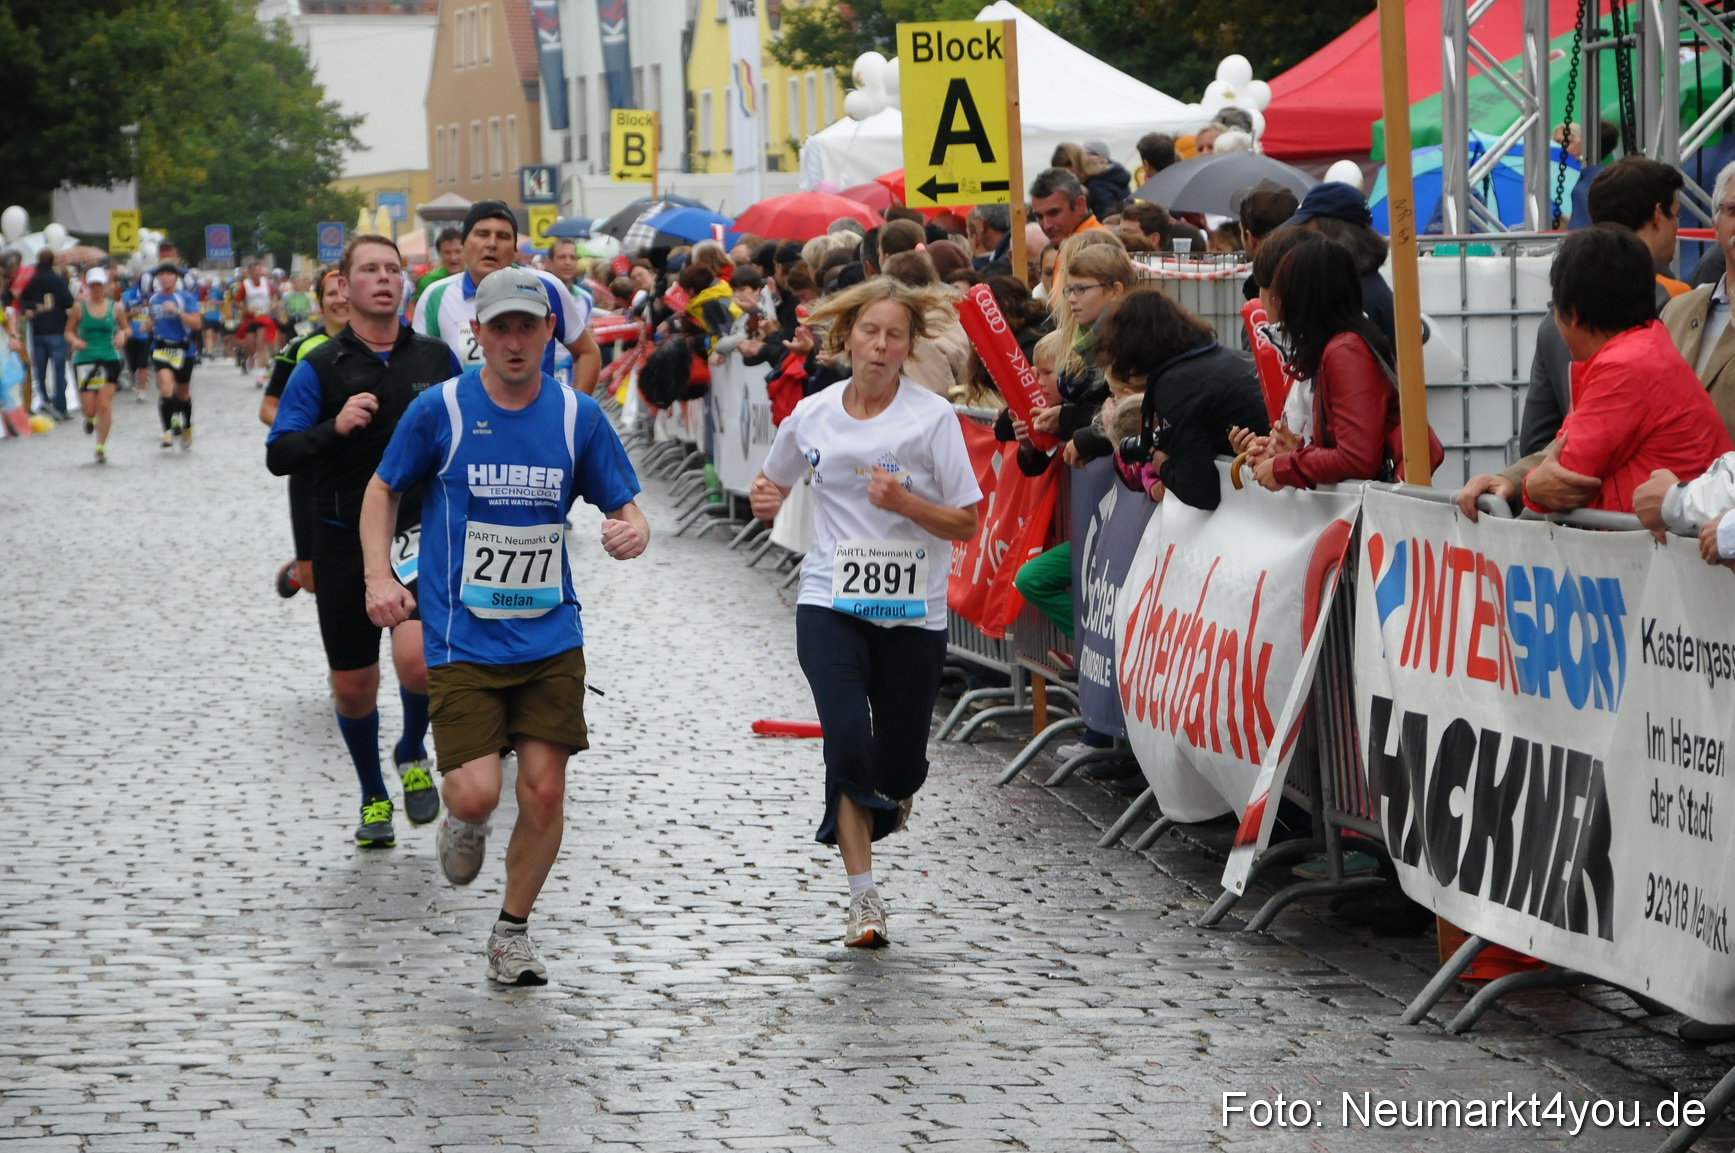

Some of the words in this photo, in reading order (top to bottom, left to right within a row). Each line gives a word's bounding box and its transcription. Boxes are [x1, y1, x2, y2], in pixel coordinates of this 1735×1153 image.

[912, 28, 1003, 63] Block
[616, 112, 653, 126] Block
[928, 77, 997, 166] A
[623, 132, 646, 166] B
[116, 221, 132, 242] C
[1006, 347, 1036, 388] BKK
[467, 463, 564, 489] HUBER
[489, 487, 559, 498] TECHNOLOGY
[468, 531, 502, 544] PARTL
[504, 536, 546, 545] Neumarkt
[836, 548, 867, 557] PARTL
[869, 548, 913, 558] Neumarkt
[473, 547, 553, 584] 2777
[843, 562, 917, 595] 2891
[491, 592, 534, 606] Stefan
[853, 602, 906, 616] Gertraud
[1400, 537, 1628, 714] INTERSPORT
[1120, 543, 1276, 766] Oberbank
[1646, 711, 1667, 762] Im
[1671, 717, 1725, 777] Herzen
[1650, 778, 1674, 829] der
[1678, 783, 1714, 842] Stadt
[1645, 871, 1689, 932] 92318
